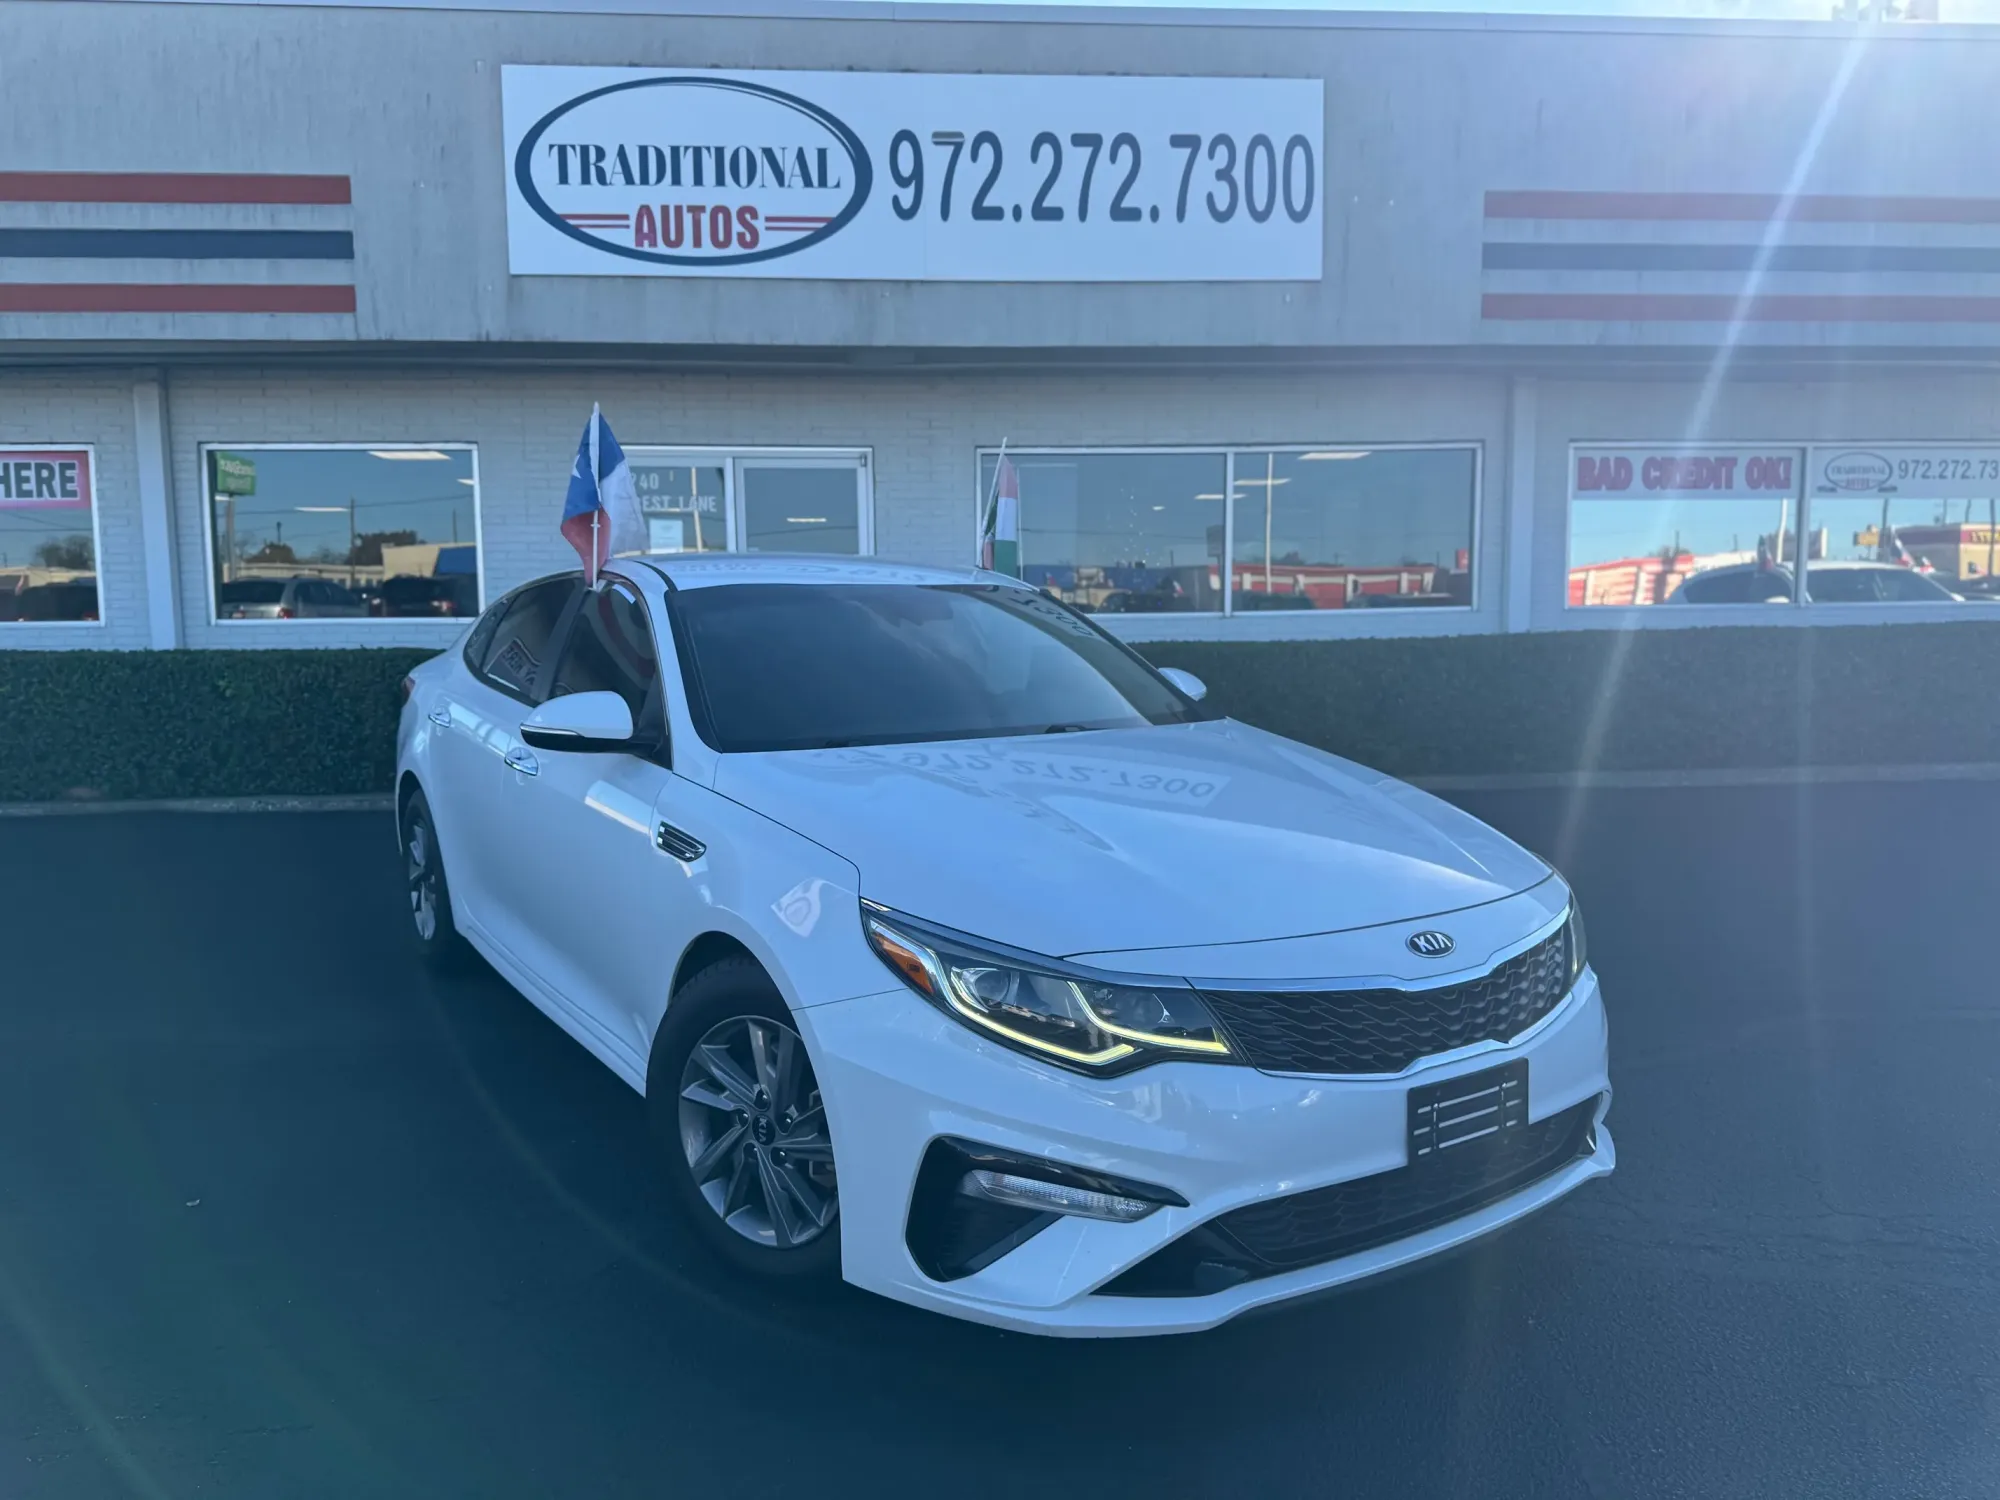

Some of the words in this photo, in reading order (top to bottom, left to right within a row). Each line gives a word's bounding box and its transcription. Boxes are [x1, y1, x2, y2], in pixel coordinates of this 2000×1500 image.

[547, 143, 841, 189] TRADITIONAL
[888, 128, 1316, 224] 972.272.7300
[634, 204, 761, 249] AUTOS
[0, 461, 80, 499] HERE
[1577, 456, 1633, 491] BAD
[1641, 456, 1738, 491] CREDIT
[1745, 455, 1793, 490] OK!
[1898, 459, 2000, 479] 972.272.73
[1411, 932, 1453, 953] KIA
